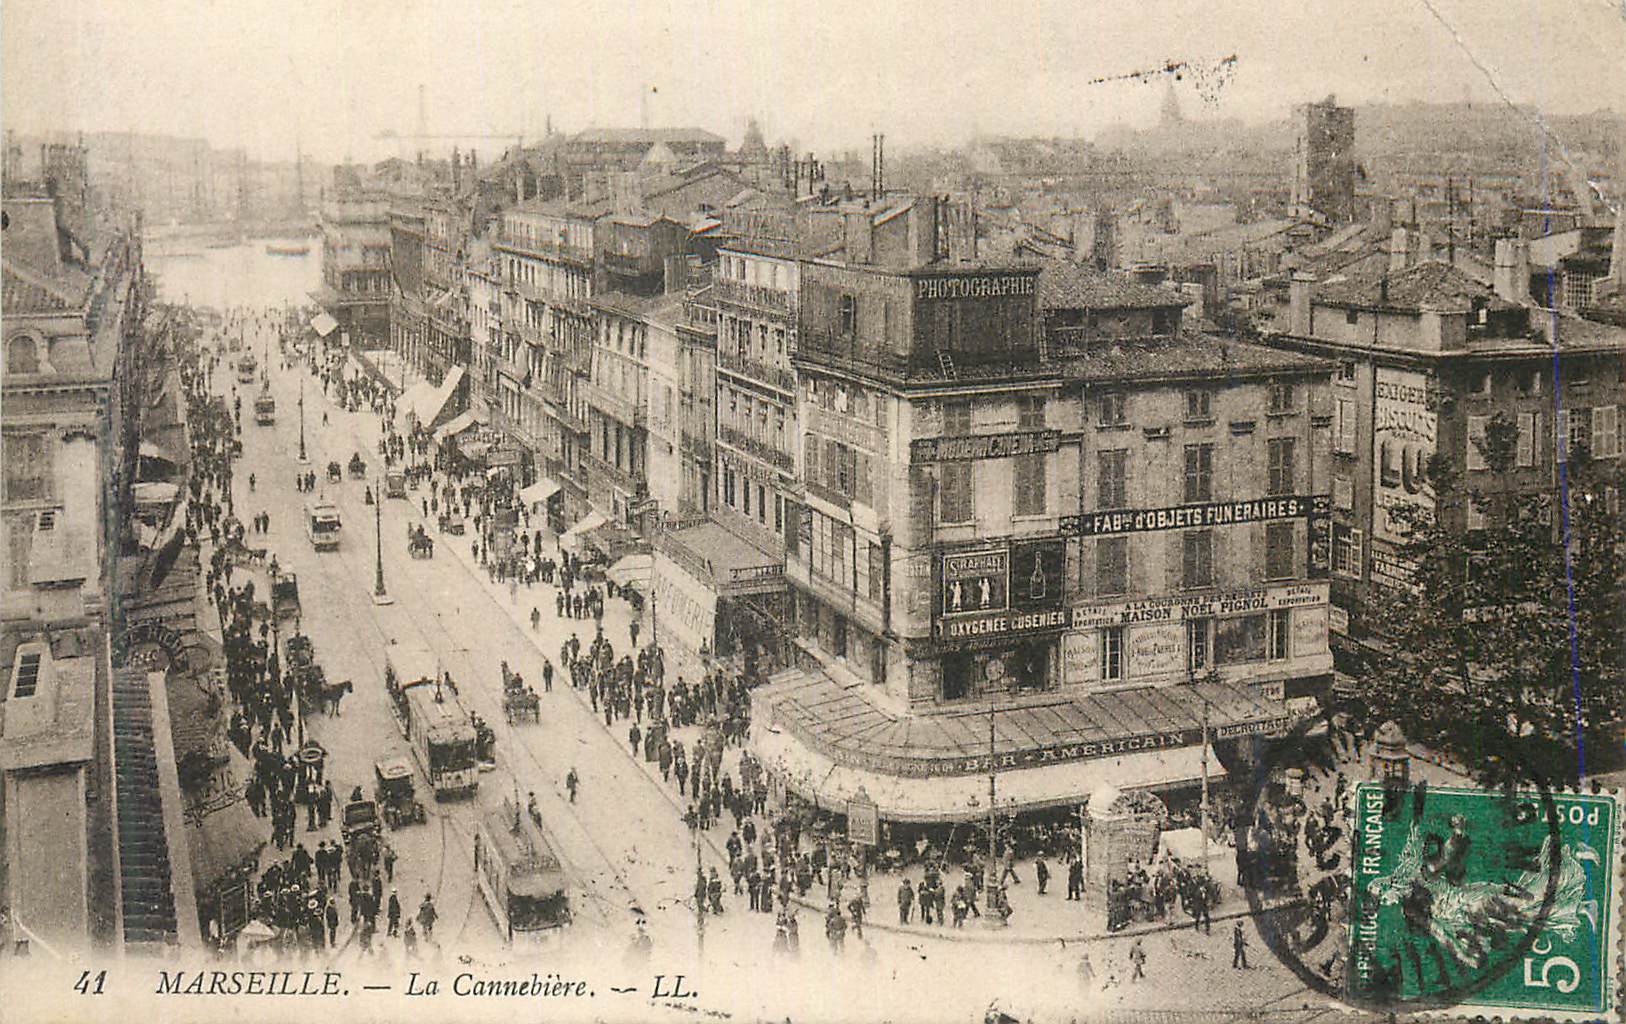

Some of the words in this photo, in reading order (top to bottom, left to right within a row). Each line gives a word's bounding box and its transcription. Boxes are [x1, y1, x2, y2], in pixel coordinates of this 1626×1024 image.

[918, 276, 1033, 299] PHOTOGRAPHIE
[1011, 611, 1065, 630] CUSENIER
[1120, 608, 1172, 623] MAISON
[1220, 599, 1269, 613] PIGNOL
[966, 752, 1016, 771] BAR
